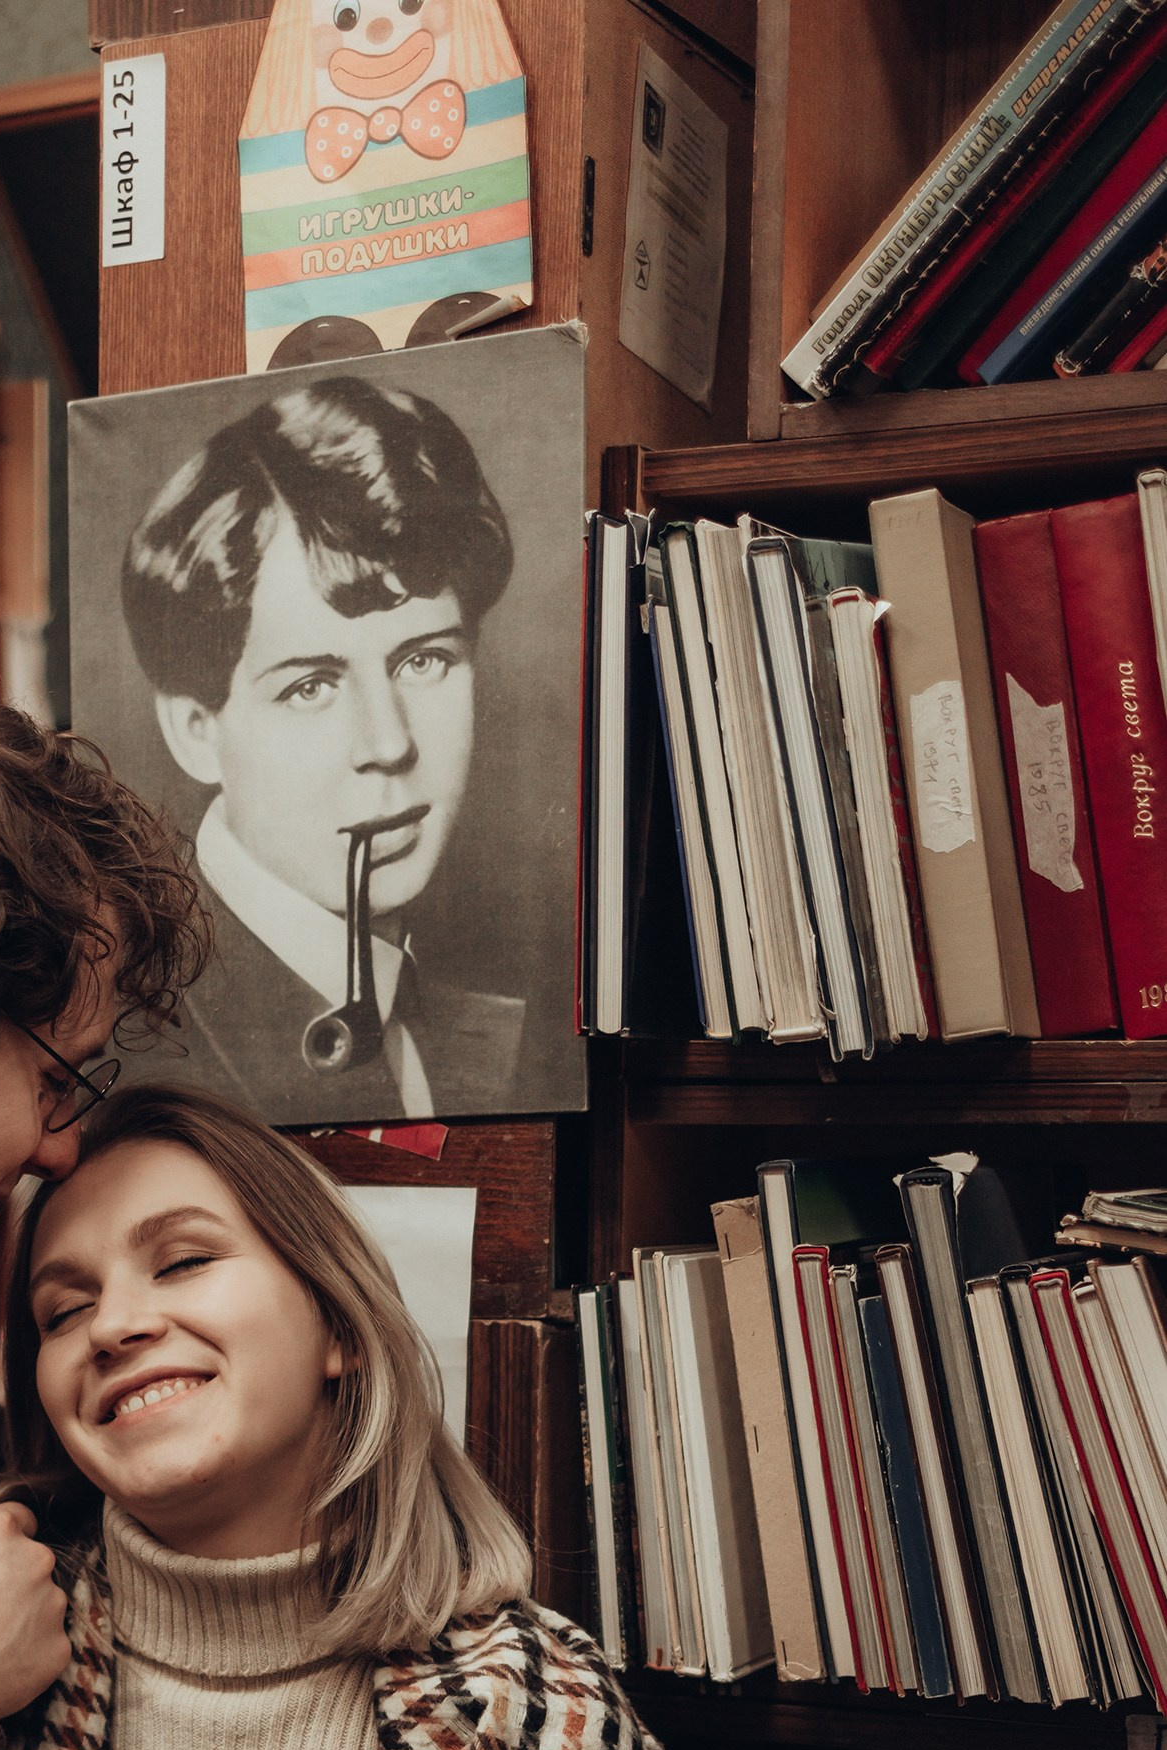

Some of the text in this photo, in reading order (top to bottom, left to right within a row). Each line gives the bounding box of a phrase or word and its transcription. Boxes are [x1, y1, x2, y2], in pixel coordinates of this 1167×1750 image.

[111, 70, 139, 248] Шкаф 1-25
[299, 185, 475, 241] ИГРУШКИ-
[861, 114, 1012, 289] ОКТЯБРЬСКИЙ:
[301, 222, 469, 274] ПОДУШКИ
[1019, 254, 1092, 337] ВНЕВЕДОМСТВЕННАЯ
[1090, 225, 1121, 258] ОХРАНА
[1117, 173, 1166, 227] РЕСПУБЛИКИ
[1027, 761, 1052, 814] 1985
[1118, 660, 1156, 840] Вокруг света
[1139, 983, 1167, 1009] 19
